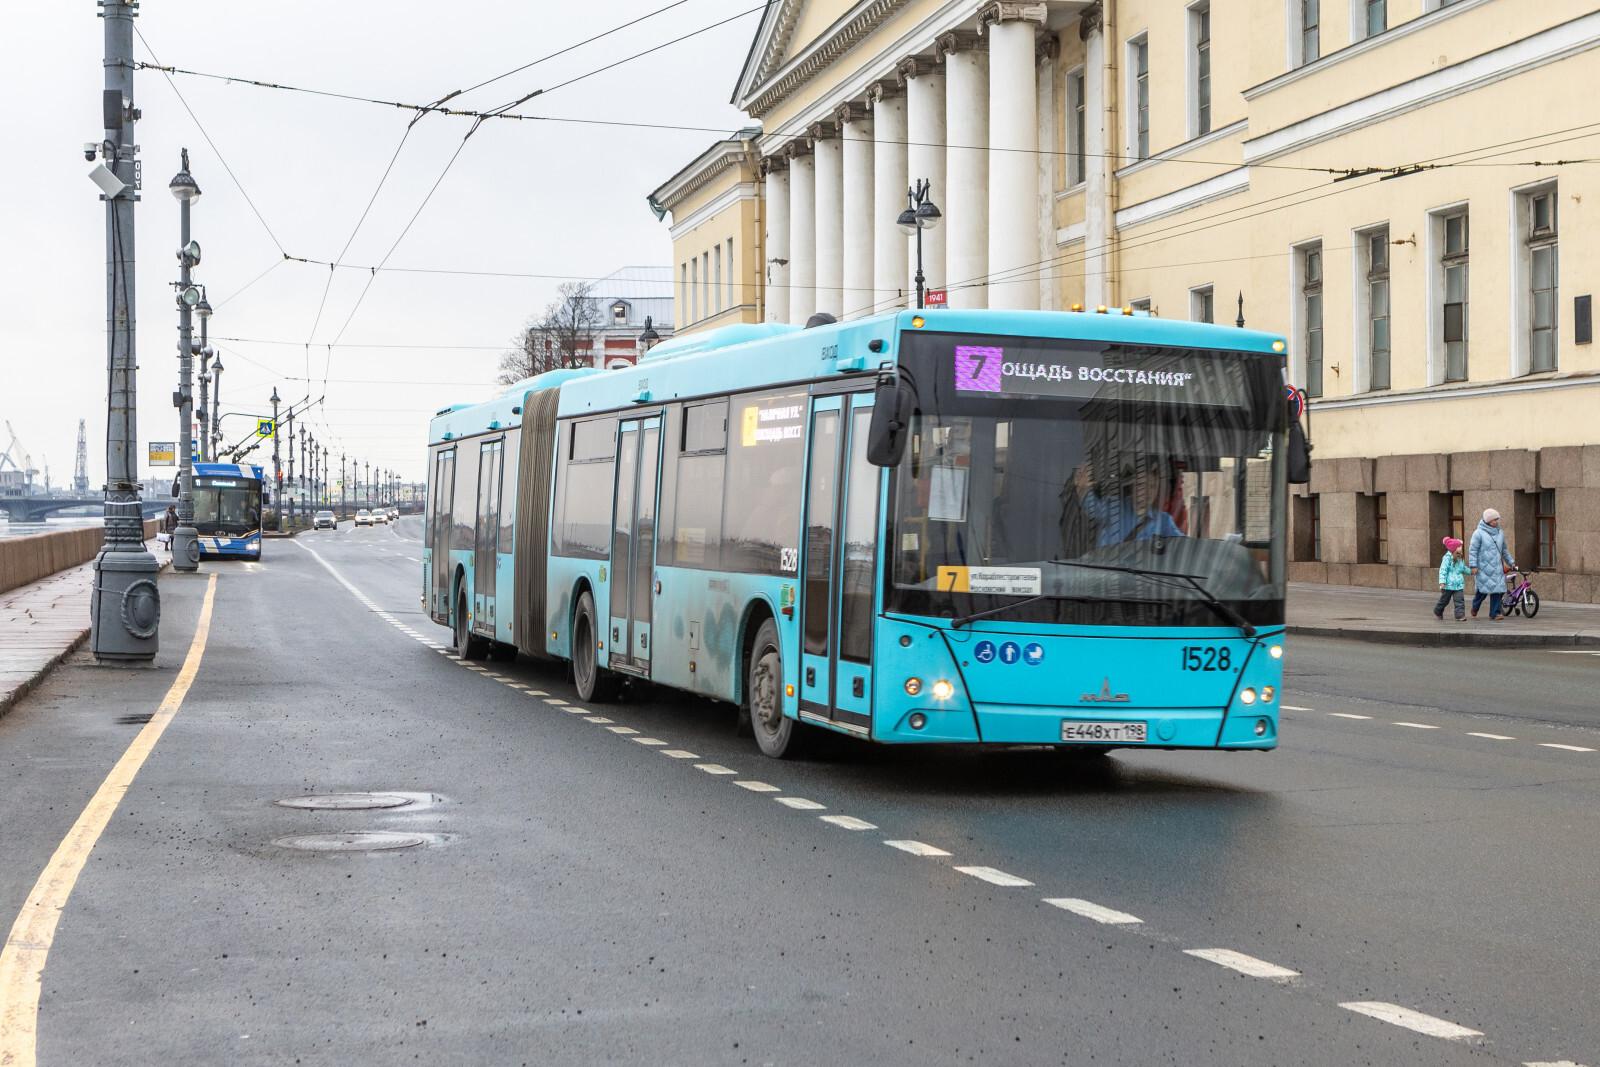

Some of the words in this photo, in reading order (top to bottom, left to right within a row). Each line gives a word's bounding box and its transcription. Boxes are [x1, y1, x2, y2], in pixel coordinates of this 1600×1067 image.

[969, 354, 987, 380] 7
[780, 547, 797, 571] 1528
[947, 572, 957, 592] 7
[1182, 646, 1231, 672] 1528
